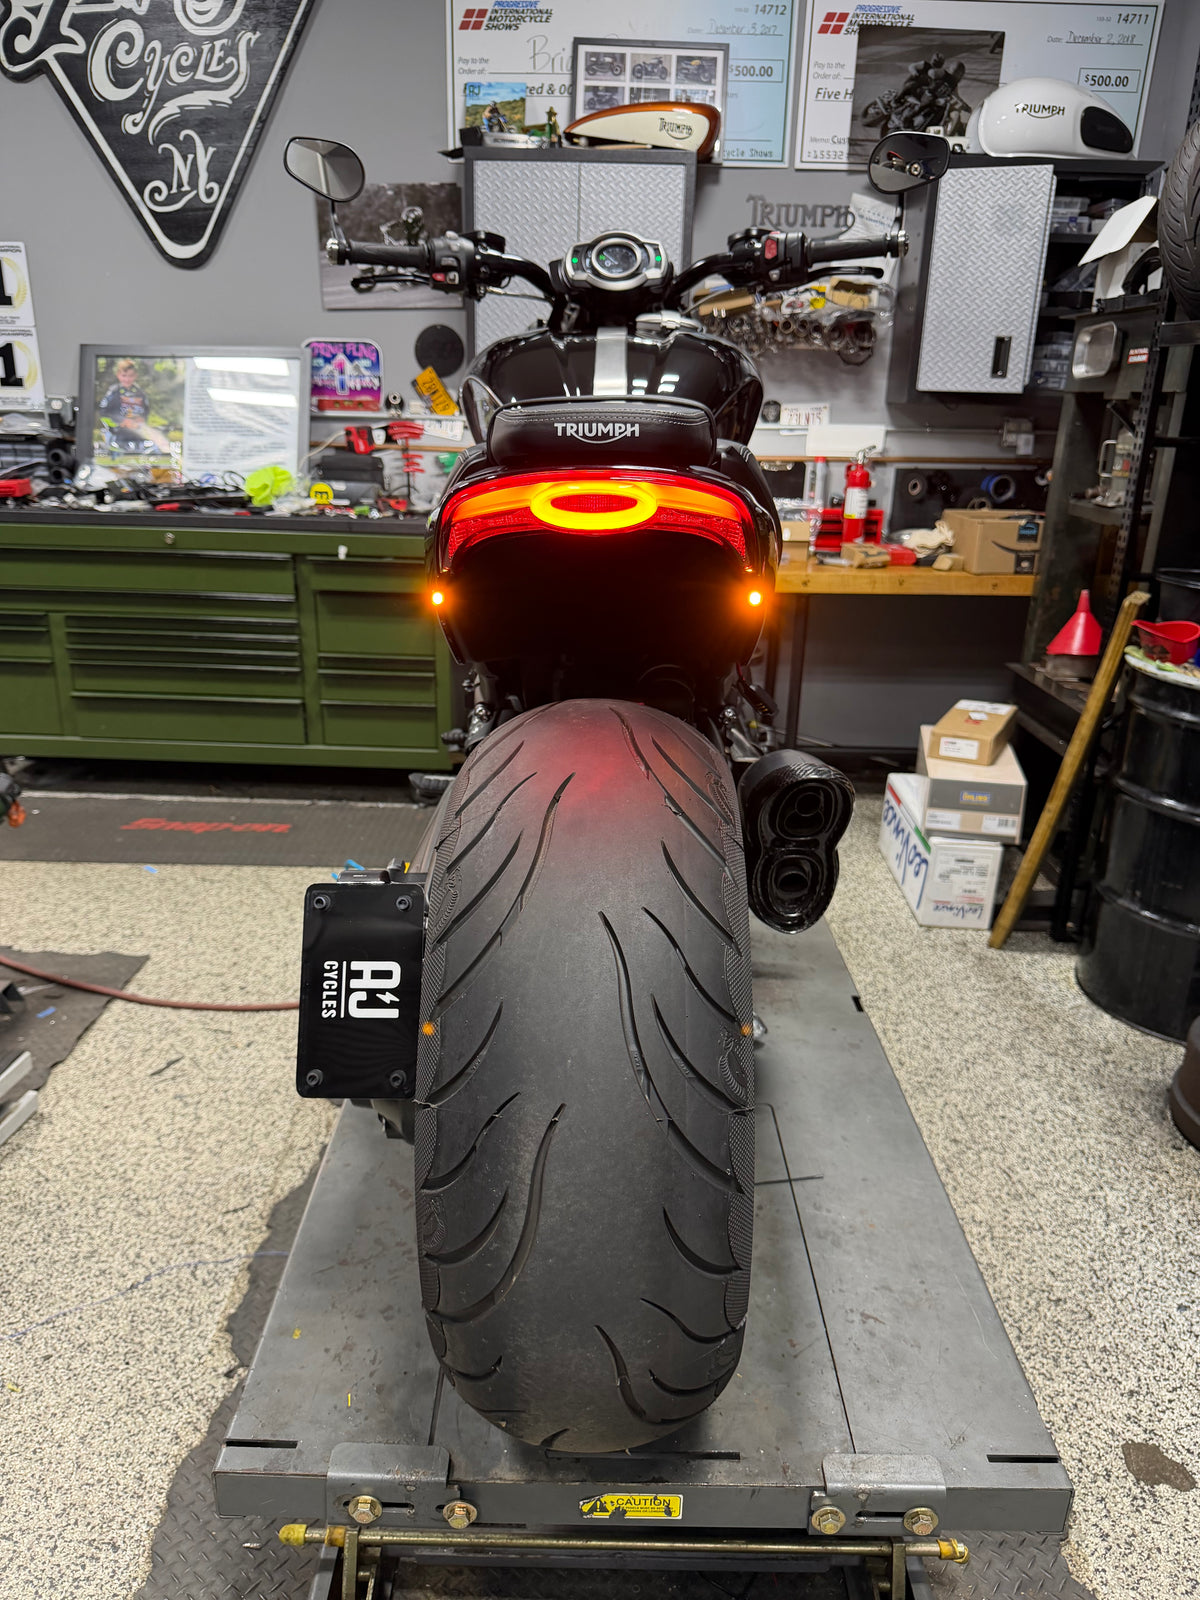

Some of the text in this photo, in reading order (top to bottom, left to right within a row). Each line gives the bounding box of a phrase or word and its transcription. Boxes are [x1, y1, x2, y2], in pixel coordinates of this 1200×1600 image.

[754, 4, 787, 15] 14712
[487, 15, 552, 23] MOTORCYCLE
[1116, 13, 1149, 24] 14711
[484, 23, 520, 31] SHOWS
[728, 66, 774, 77] $500.00
[1084, 74, 1129, 87] $500.00
[815, 88, 841, 99] Five
[1014, 103, 1066, 118] TRIUMPH
[659, 117, 693, 140] TRIUMPH
[723, 149, 745, 159] cycle
[143, 129, 220, 212] NY
[746, 194, 855, 232] TRIUMPH
[554, 422, 640, 444] TRIUMPH
[321, 960, 339, 1019] CYCLES
[348, 960, 402, 1018] AJ
[616, 1498, 671, 1506] CAUTION
